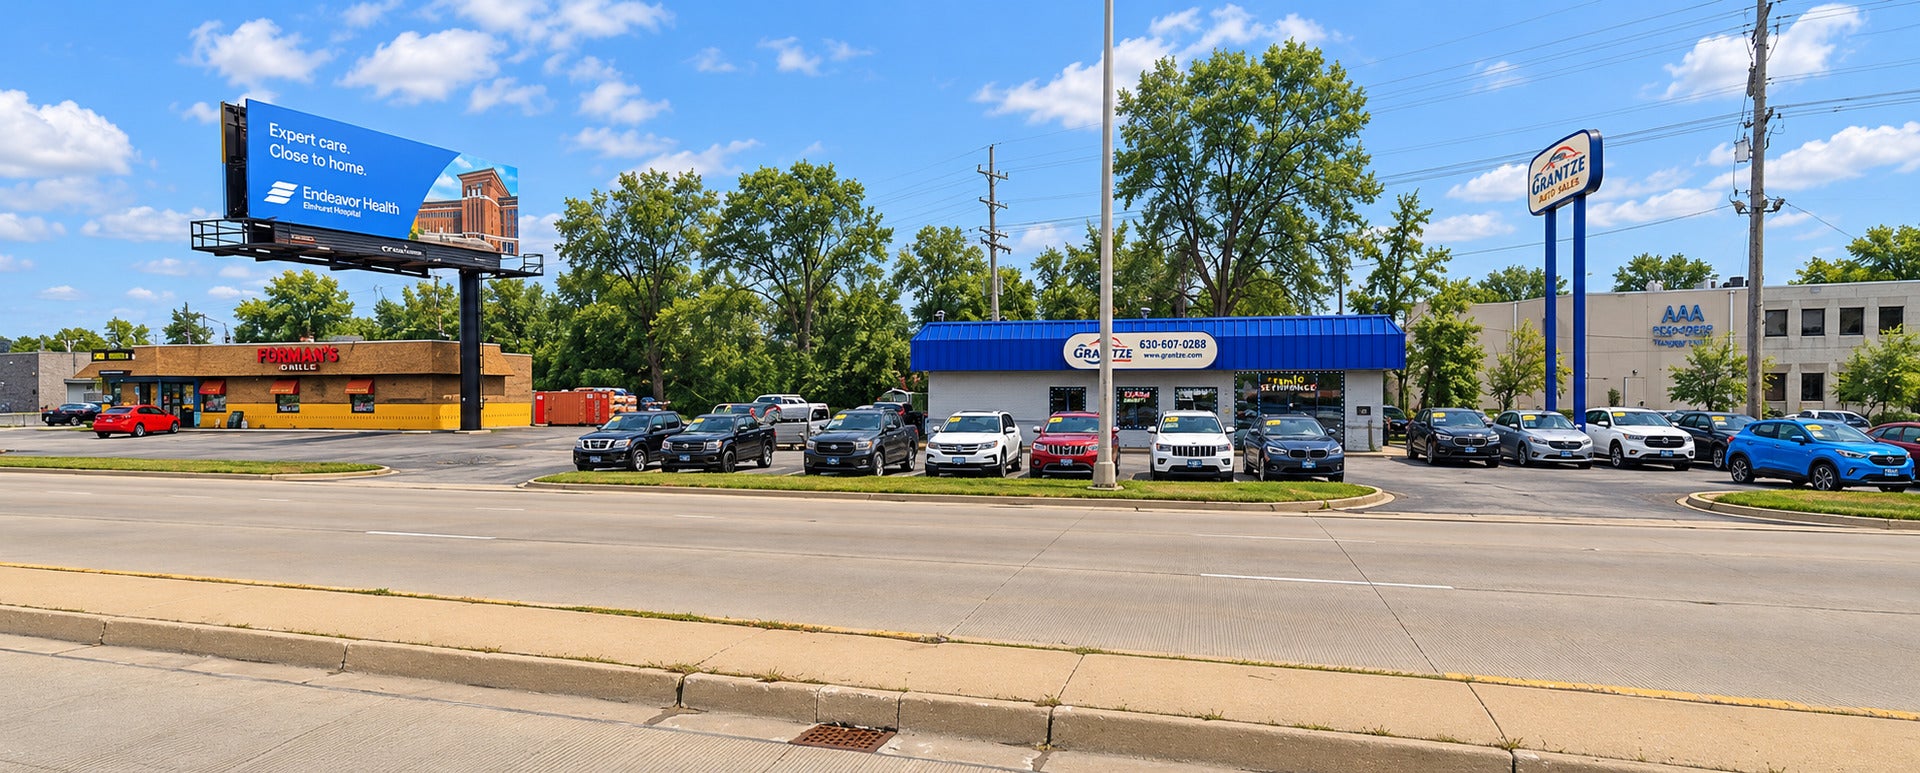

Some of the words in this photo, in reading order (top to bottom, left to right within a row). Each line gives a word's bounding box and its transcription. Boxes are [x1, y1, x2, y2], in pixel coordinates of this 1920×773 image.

[269, 122, 316, 146] Expert
[319, 137, 351, 155] care.
[269, 143, 309, 164] Close
[311, 153, 326, 167] to
[329, 155, 367, 176] home.
[1532, 155, 1586, 195] GRANTZE
[303, 185, 361, 208] Endeavor
[363, 197, 400, 216] Health
[1539, 188, 1556, 203] AUTO
[1558, 177, 1580, 194] SALES
[1661, 304, 1705, 323] AAA
[257, 345, 339, 363] FORMAN'S
[1073, 347, 1133, 359] GRATZE
[1139, 339, 1207, 349] 630-607-0288
[1143, 352, 1203, 360] www.grantze.com
